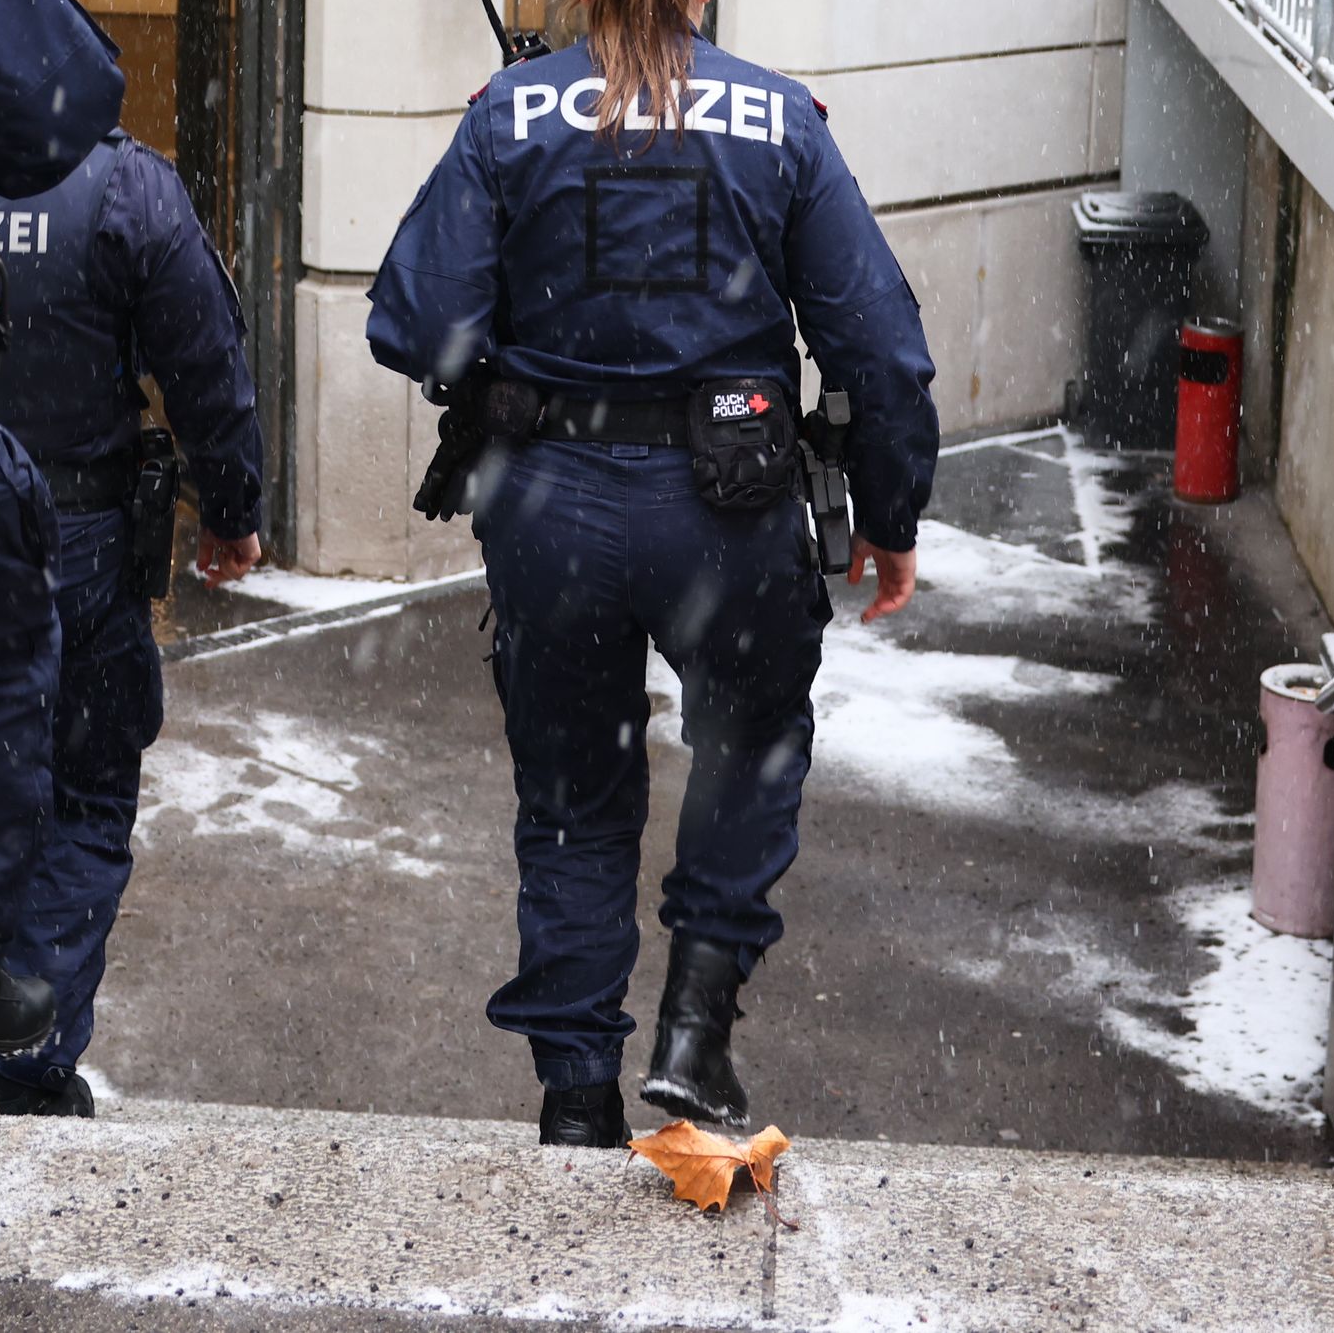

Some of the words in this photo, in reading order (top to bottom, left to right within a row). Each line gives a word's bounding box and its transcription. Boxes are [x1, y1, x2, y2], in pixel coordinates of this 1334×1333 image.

[513, 77, 785, 147] POLIZEI
[715, 393, 745, 406] OUCH
[712, 404, 750, 418] POUCH
